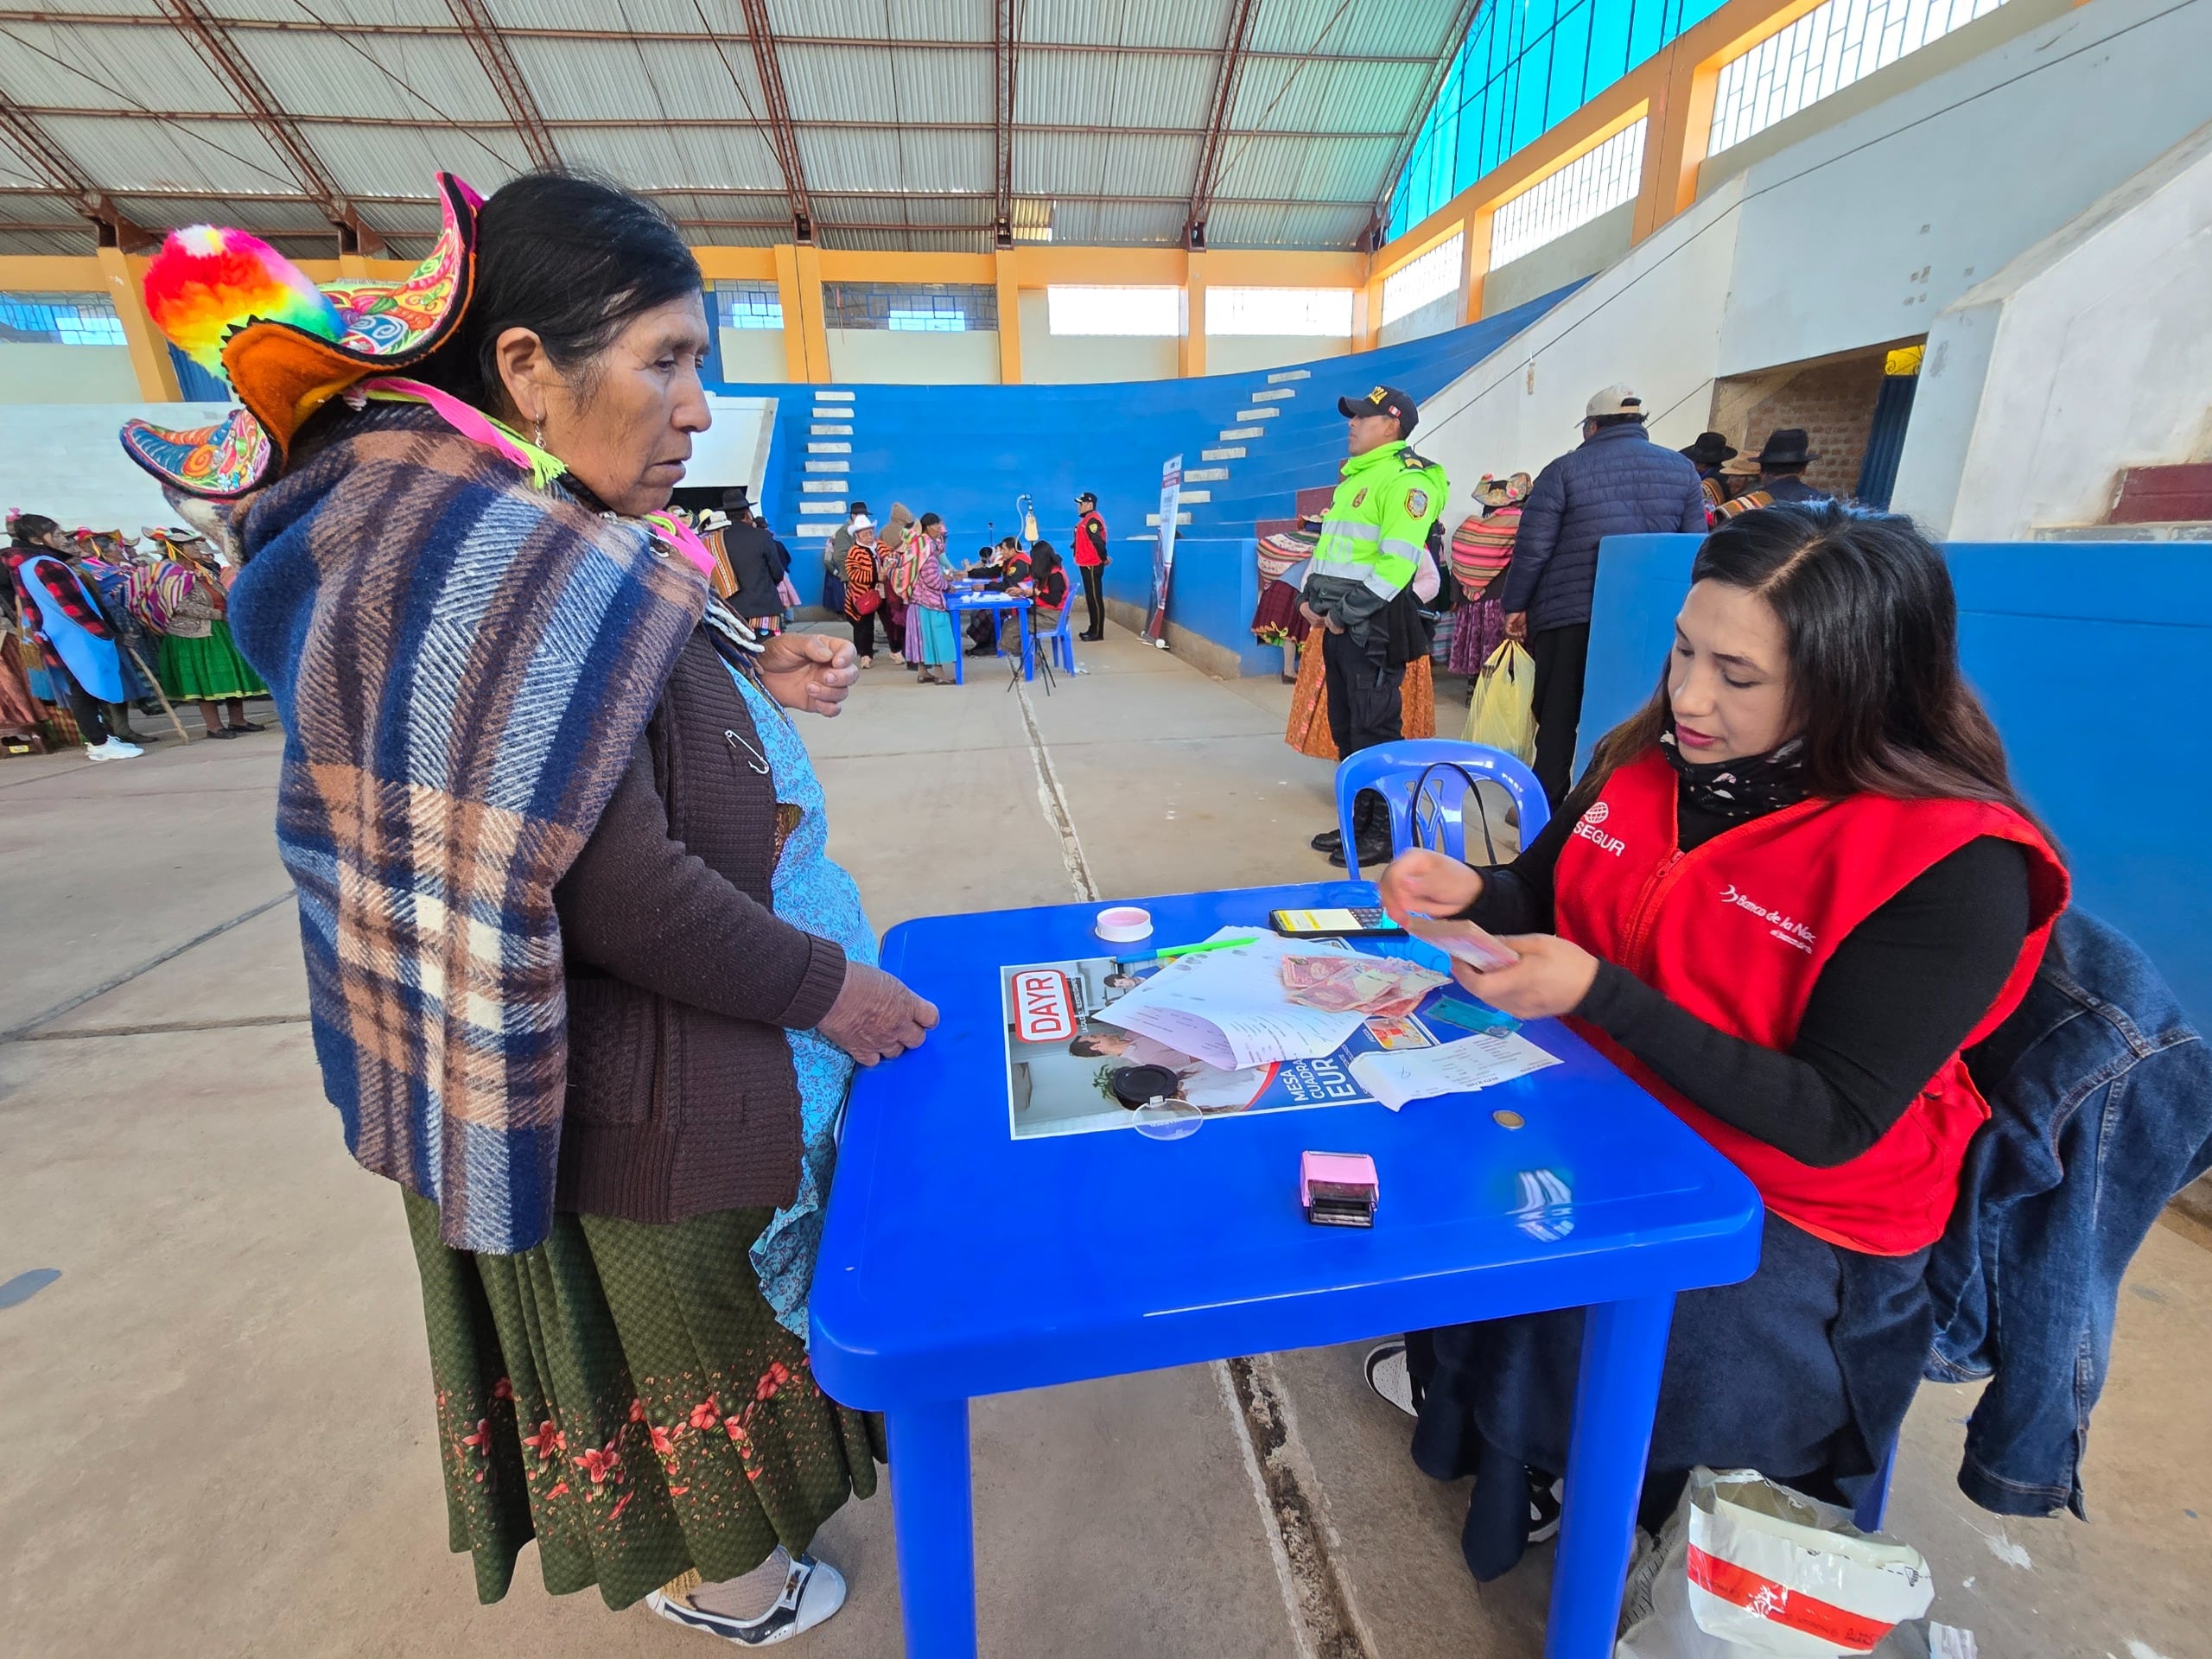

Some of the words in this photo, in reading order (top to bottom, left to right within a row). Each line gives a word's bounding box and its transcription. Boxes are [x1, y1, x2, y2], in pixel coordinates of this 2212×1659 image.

[1573, 820, 1625, 857] SEGUR
[1736, 894, 1767, 917] Banco
[1765, 910, 1782, 925] de
[1779, 916, 1795, 931] la
[1025, 976, 1062, 1033] DAYR
[1279, 1068, 1310, 1102] MESA
[1292, 1058, 1325, 1100] CUADRA
[1311, 1058, 1357, 1098] EUR
